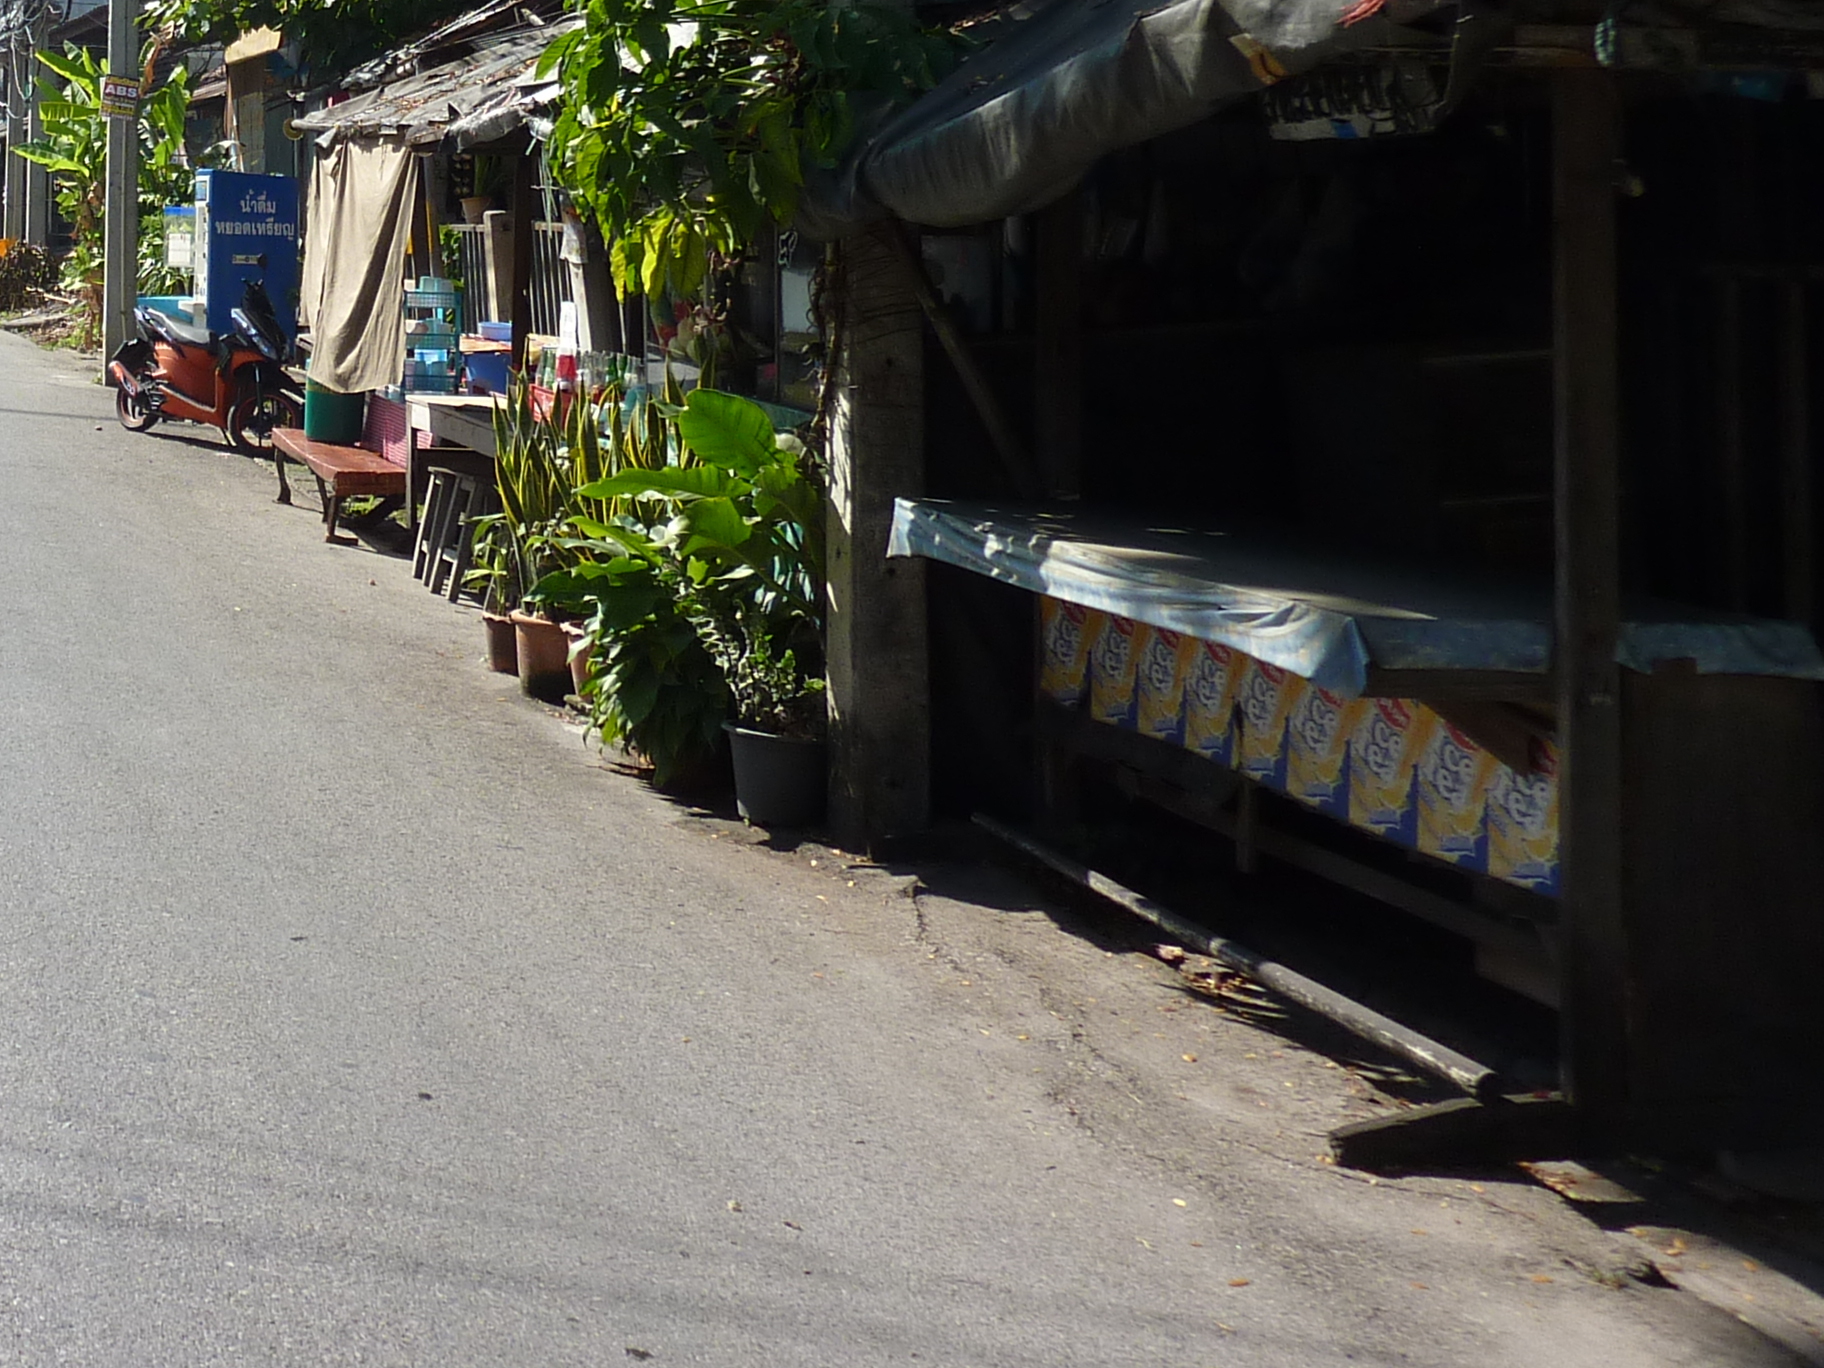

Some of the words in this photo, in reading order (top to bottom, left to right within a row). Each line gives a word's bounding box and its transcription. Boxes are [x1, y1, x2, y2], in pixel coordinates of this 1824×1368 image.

[105, 84, 138, 98] ABS
[240, 189, 276, 214] น้ำดื่ม
[215, 217, 295, 240] หยอดเหรียญ
